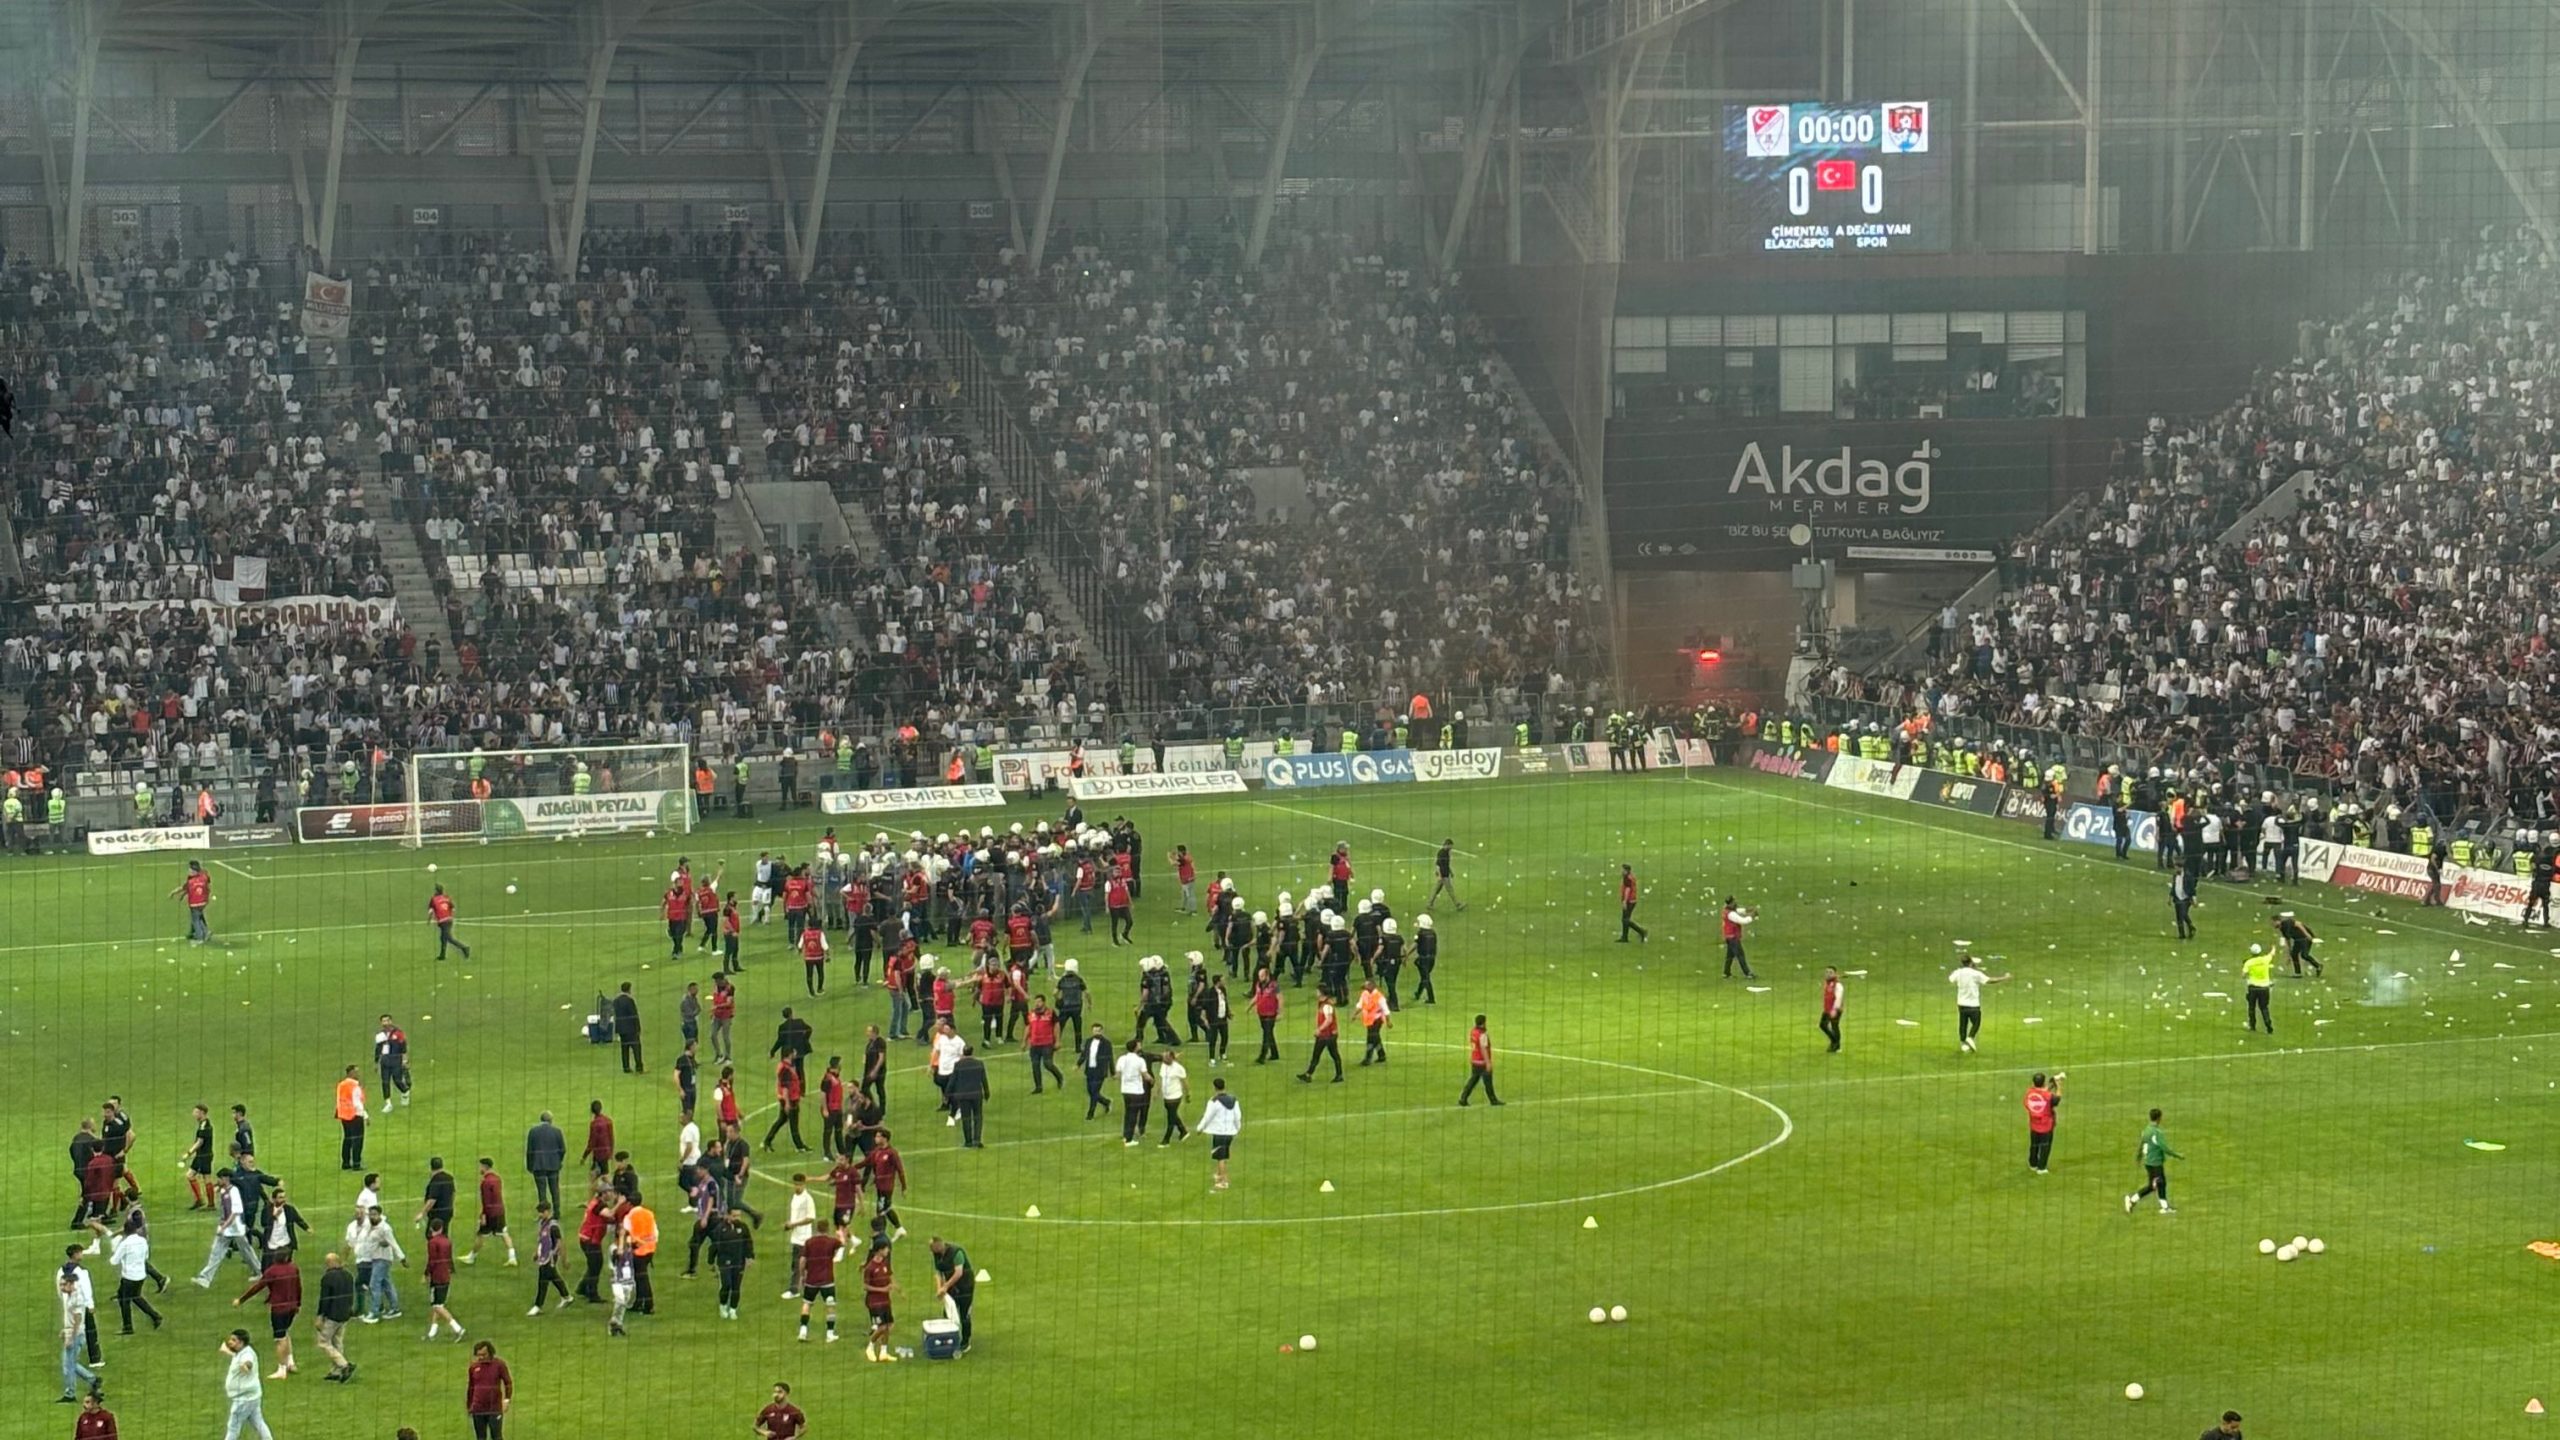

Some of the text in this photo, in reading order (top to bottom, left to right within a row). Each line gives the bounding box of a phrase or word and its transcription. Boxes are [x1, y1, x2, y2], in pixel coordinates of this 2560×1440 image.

[1798, 115, 1874, 144] 00:00
[1789, 167, 1809, 215] 0
[1862, 165, 1882, 214] 0
[113, 212, 137, 223] 303
[415, 211, 437, 222] 304
[1835, 225, 1846, 236] A
[1886, 224, 1911, 235] VAN
[1857, 236, 1888, 248] SPOR
[1727, 439, 1931, 514] Akdağ
[1769, 499, 1889, 514] MERMER
[1752, 525, 1769, 536] BU
[1814, 527, 1879, 539] TUTKUYLA
[1267, 757, 1345, 786] Q PLUS
[1352, 754, 1380, 782] Q
[1425, 750, 1497, 778] geldoy
[1116, 773, 1237, 790] DEMİRLER
[871, 786, 996, 804] DEMİRLER
[596, 797, 646, 813] PEYZAJ
[2356, 873, 2396, 894] BOTAN
